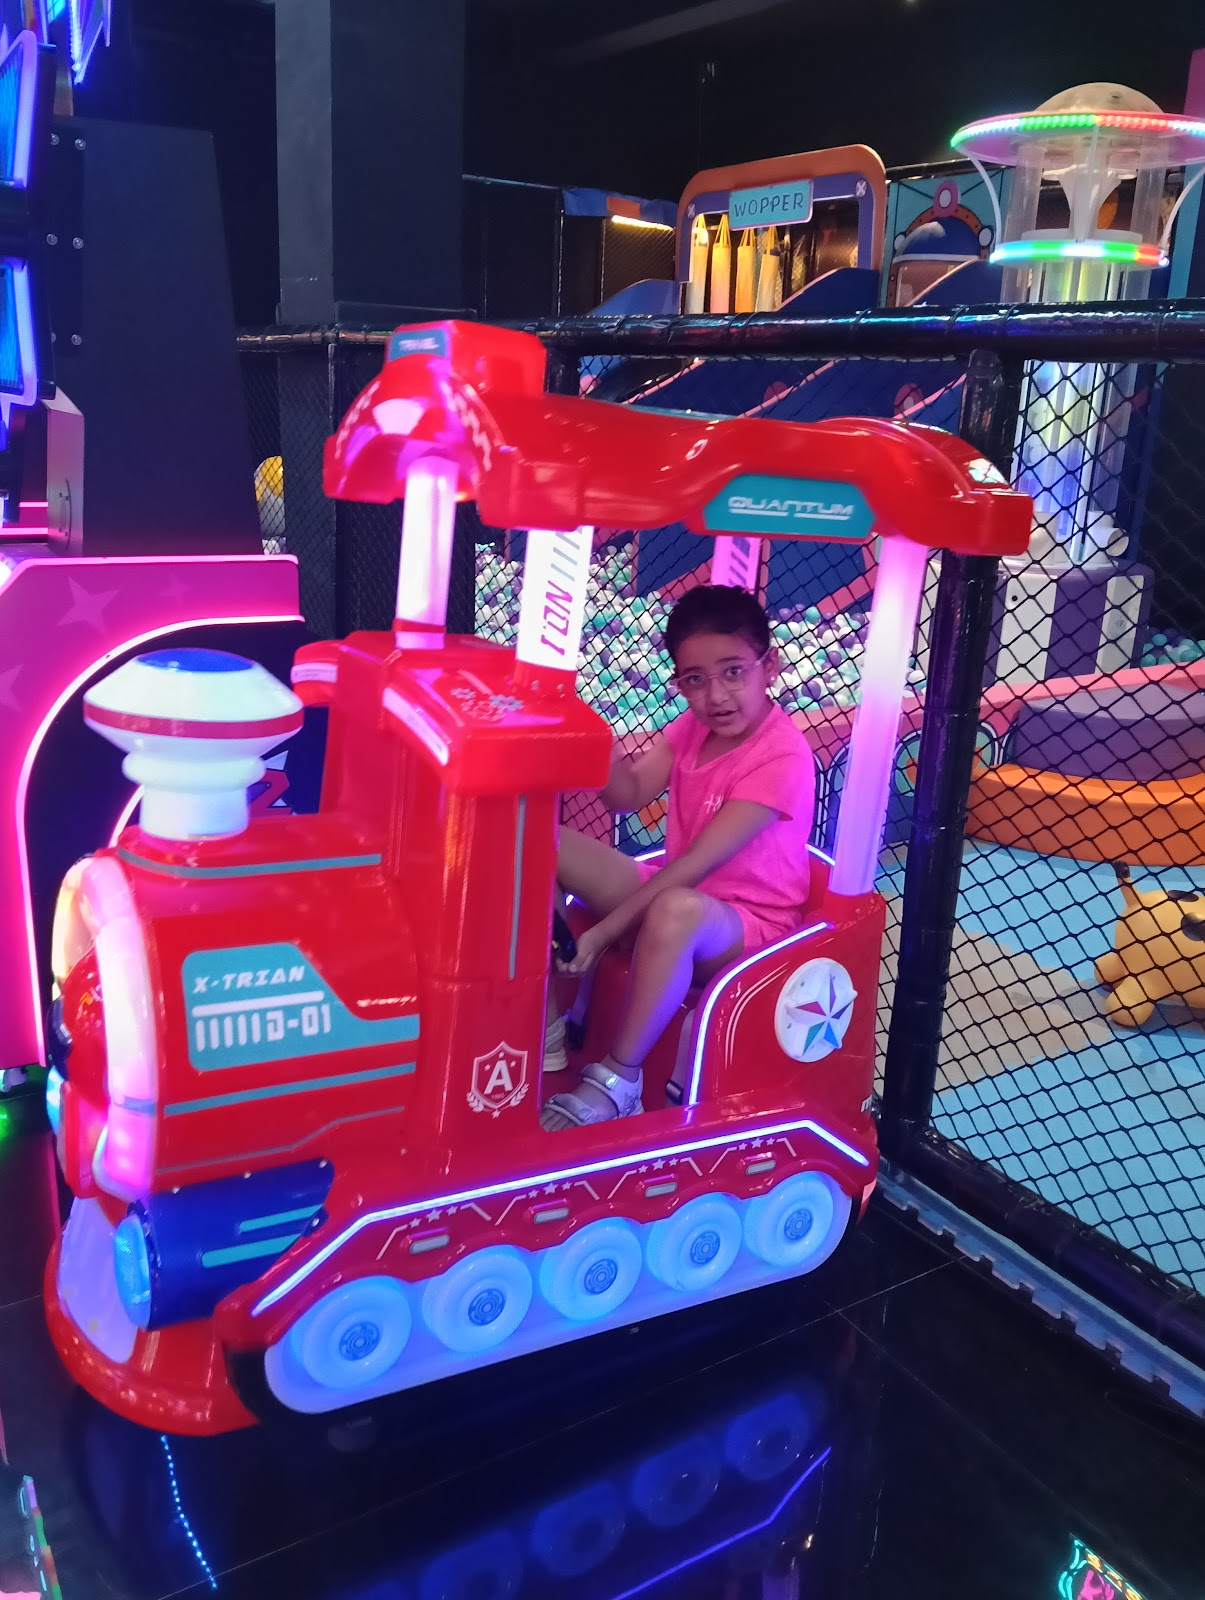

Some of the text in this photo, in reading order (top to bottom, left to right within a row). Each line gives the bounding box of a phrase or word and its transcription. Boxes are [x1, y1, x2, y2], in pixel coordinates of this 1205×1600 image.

[734, 192, 804, 218] WOPPER
[728, 496, 854, 515] QUANTUM
[192, 965, 305, 994] X-TRIAN
[483, 1059, 514, 1095] A
